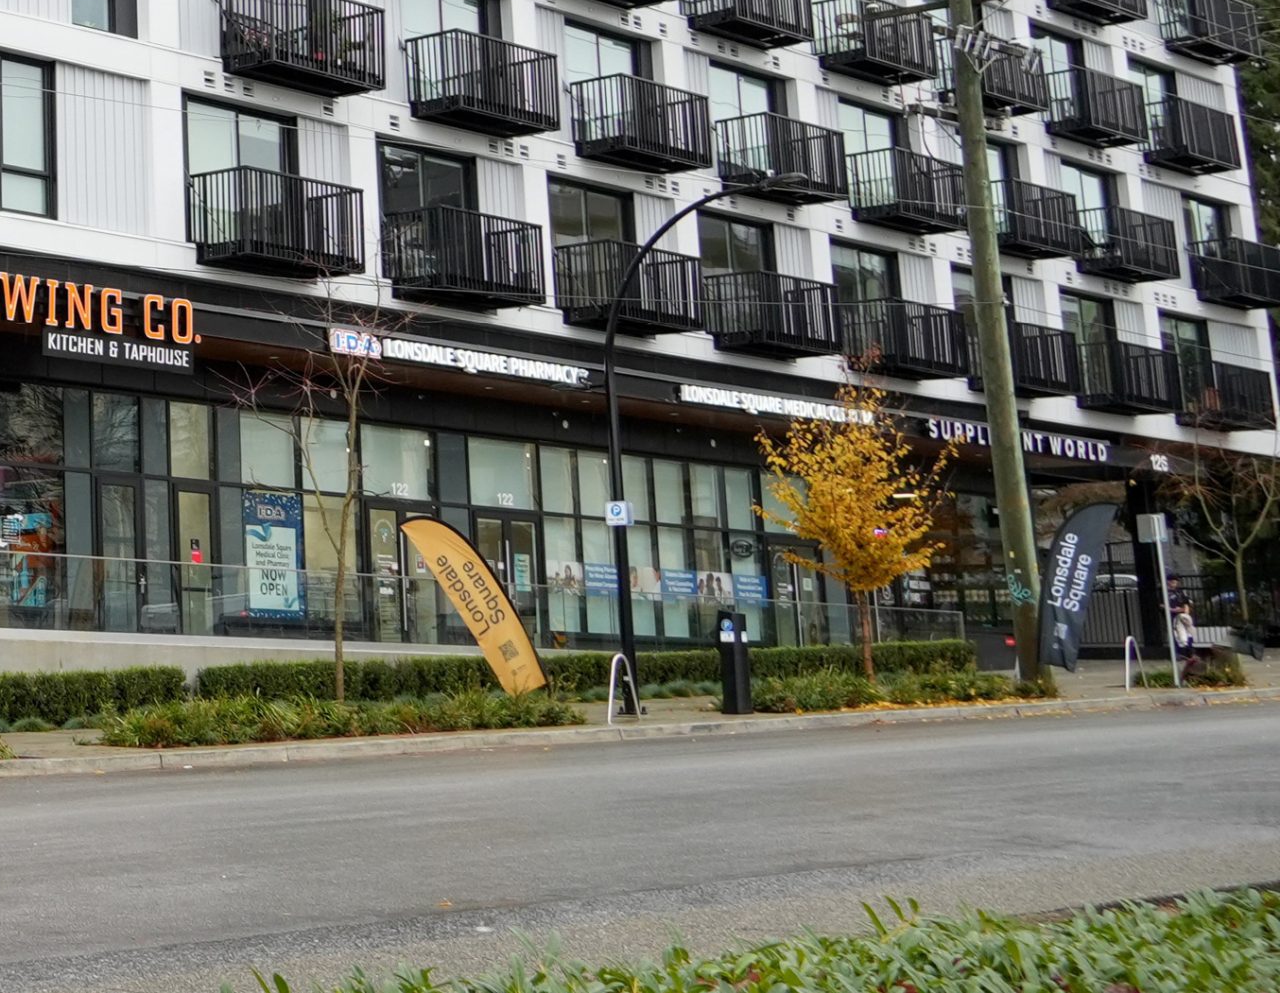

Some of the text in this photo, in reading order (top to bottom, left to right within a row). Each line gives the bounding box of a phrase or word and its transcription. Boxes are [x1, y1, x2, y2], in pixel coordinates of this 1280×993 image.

[143, 294, 202, 344] CO.
[48, 332, 190, 368] KITCHEN & TAPHOUSE
[382, 338, 454, 365] LONSDALE
[455, 349, 508, 374] SQUARE
[508, 357, 579, 385] PHARMACY
[681, 384, 740, 408] LONSDALE
[740, 392, 783, 414] SQUARE
[783, 399, 829, 421] MEDICAL
[928, 418, 1108, 462] SUPPLNT WORLD
[391, 482, 409, 496] 122
[497, 493, 514, 506] 122
[260, 582, 288, 596] OPEN
[261, 569, 287, 581] NOW
[1047, 532, 1079, 608] Lonsdale
[1063, 554, 1092, 612] Square
[436, 555, 490, 636] Lonsdale
[462, 561, 505, 625] Square
